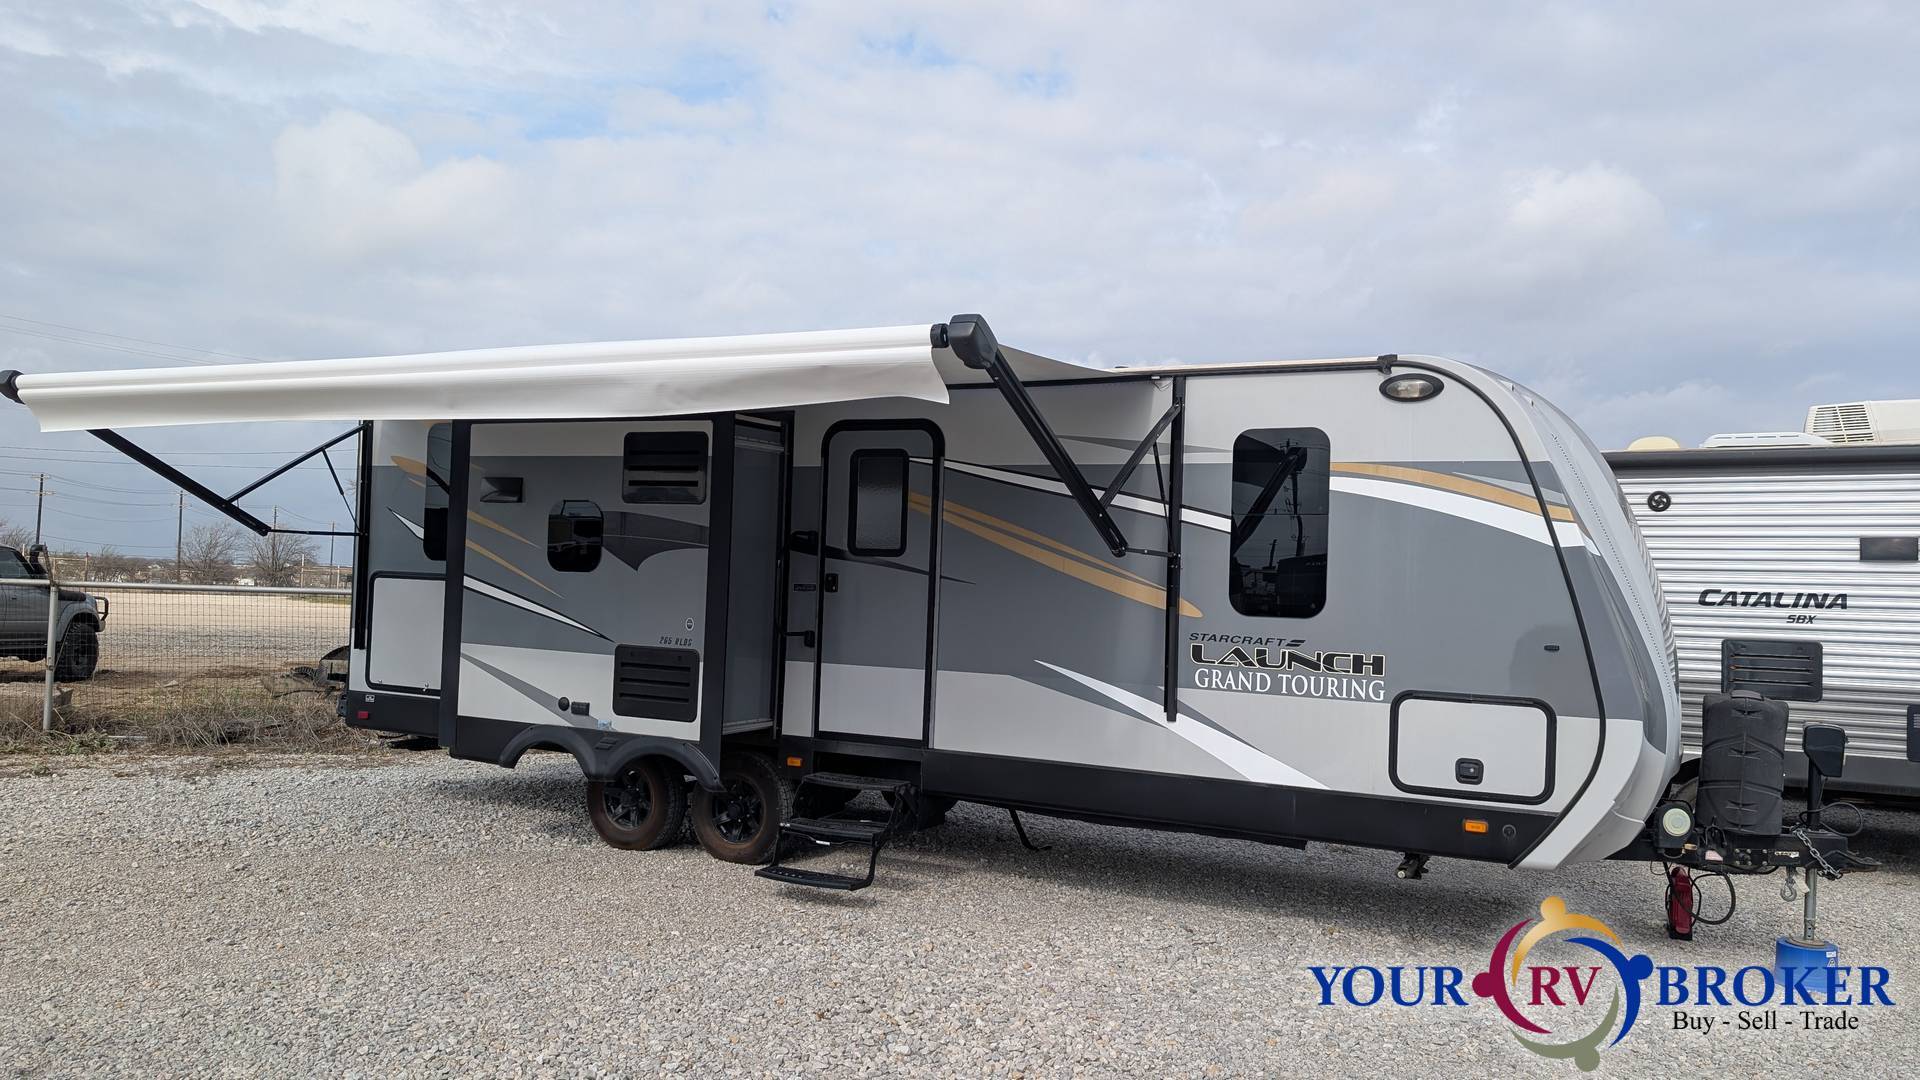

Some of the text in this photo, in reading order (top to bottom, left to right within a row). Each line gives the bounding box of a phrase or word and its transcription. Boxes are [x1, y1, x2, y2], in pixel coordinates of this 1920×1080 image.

[1698, 588, 1848, 610] CATALINA
[1786, 614, 1816, 625] SBX
[1188, 632, 1286, 647] STARCRAFT
[1190, 643, 1386, 677] LAUNCH
[1194, 667, 1386, 701] GRAND TOURING
